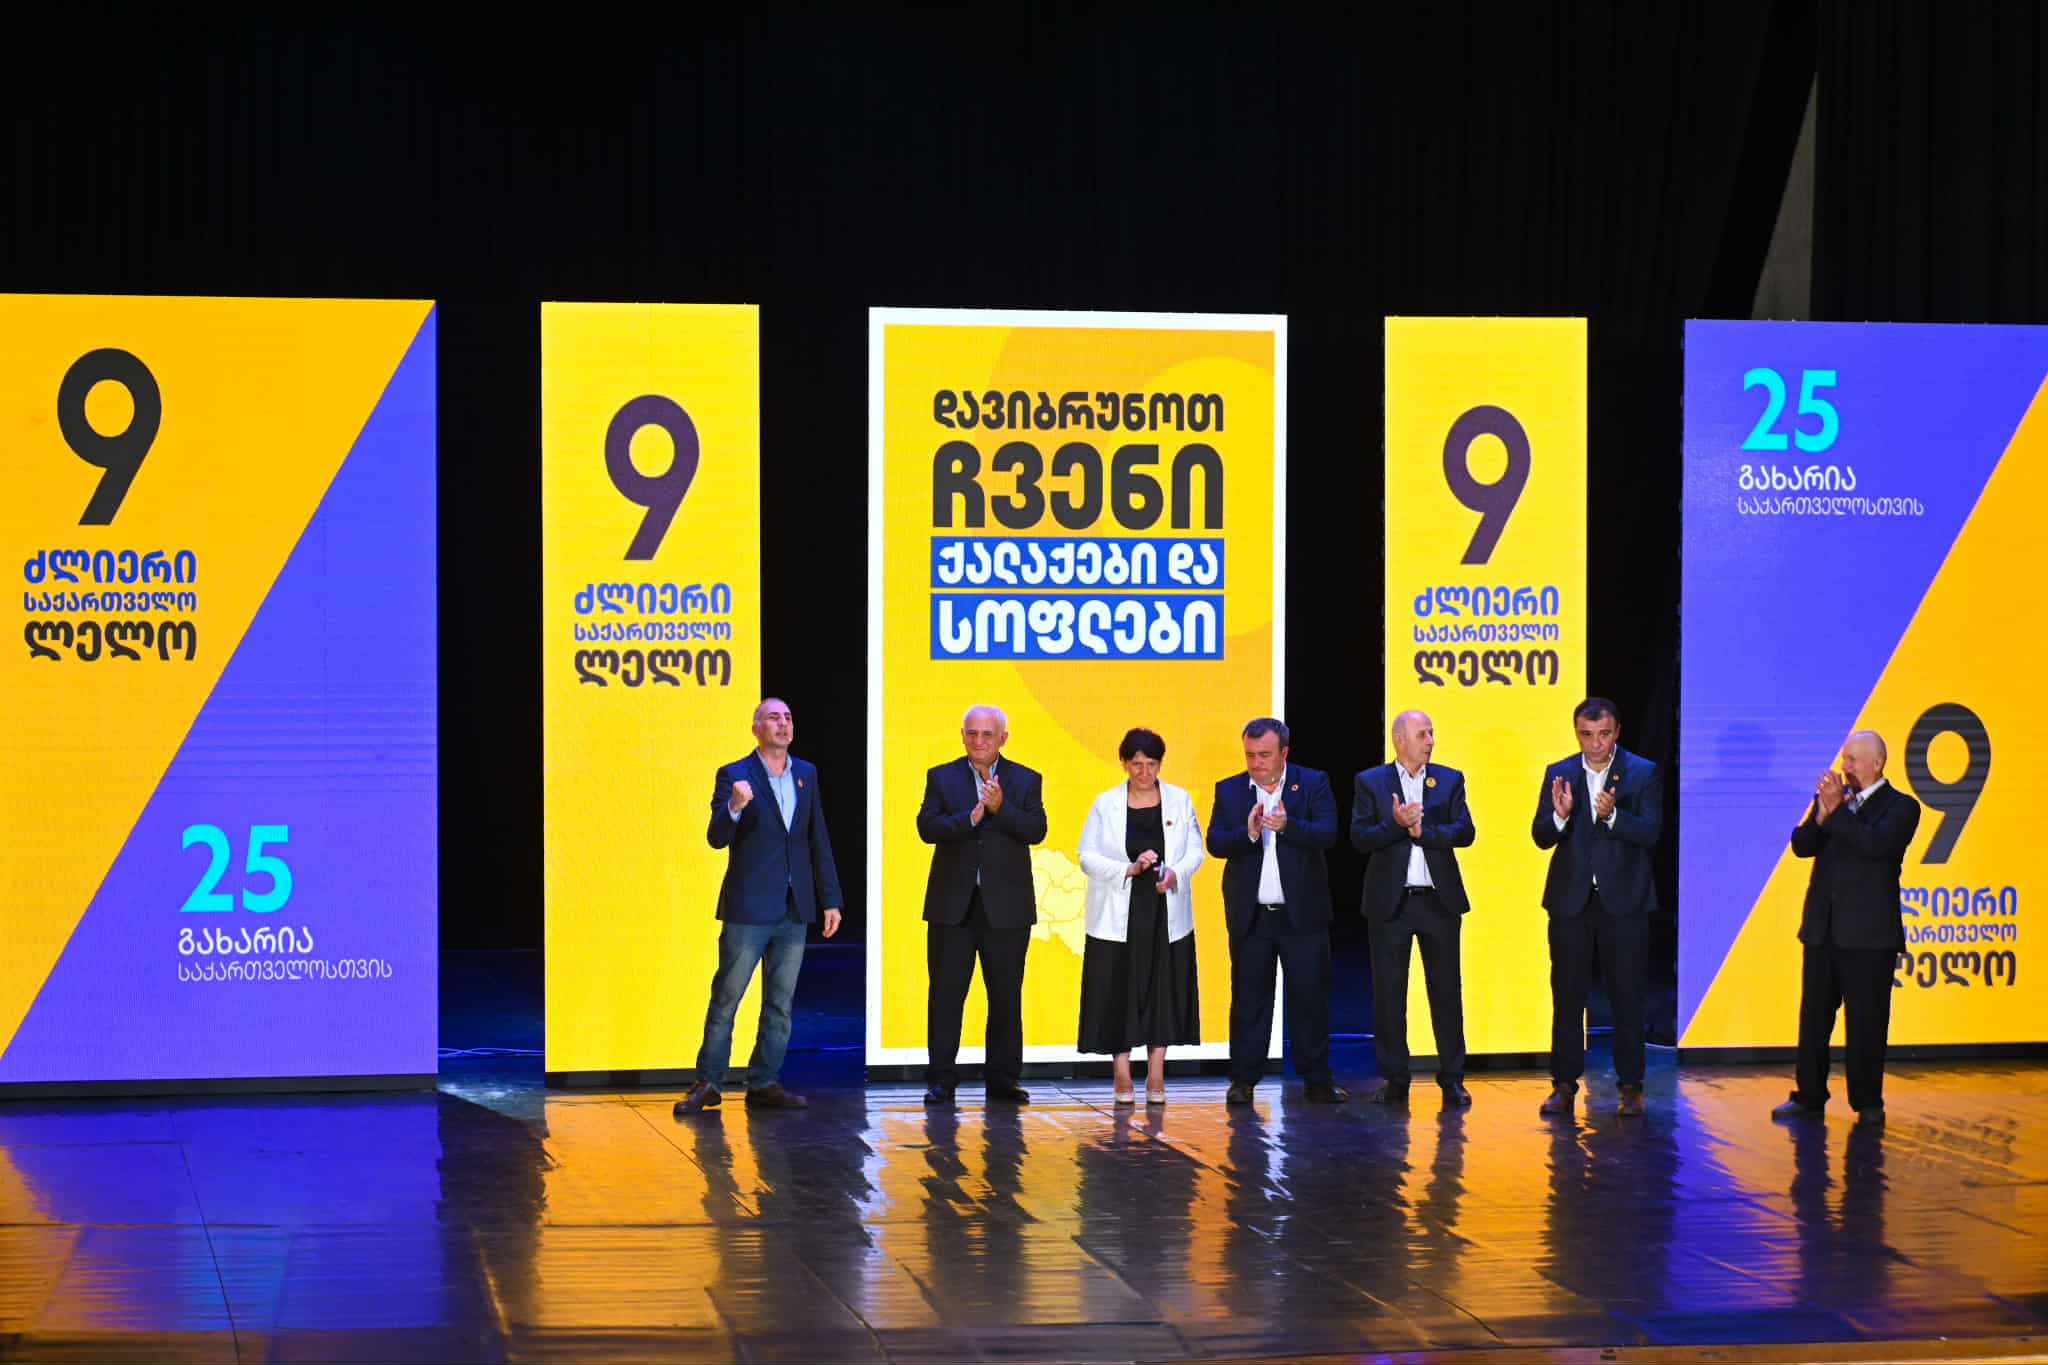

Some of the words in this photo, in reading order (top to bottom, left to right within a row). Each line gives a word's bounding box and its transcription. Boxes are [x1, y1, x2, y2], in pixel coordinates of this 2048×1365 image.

[933, 390, 1224, 432] დავიბრუნოთ
[1741, 367, 1841, 453] 25
[57, 348, 162, 525] 9
[605, 394, 701, 561] 9
[933, 441, 1224, 530] ჩვენი
[1443, 405, 1532, 565] 9
[1738, 464, 1857, 491] გახარია
[1737, 496, 1924, 516] საქართველოსთვის
[24, 550, 196, 584] ძლიერი
[938, 541, 1157, 585] ქალაქები
[1168, 542, 1218, 585] და
[24, 592, 197, 612] საქართველო
[574, 583, 732, 615] ძლიერი
[1414, 586, 1560, 618] ძლიერი
[24, 621, 196, 661] ლელო
[574, 622, 732, 642] საქართველო
[939, 599, 1216, 654] სოფლები
[1413, 623, 1560, 643] საქართველო
[574, 649, 732, 688] ლელო
[1414, 649, 1560, 687] ლელო
[1904, 702, 1992, 864] 9
[180, 824, 293, 913] 25
[1900, 886, 2017, 916] ლიერი
[178, 927, 314, 955] გახარია
[1903, 924, 2017, 943] ართველო
[178, 959, 393, 982] საქართველოსთვის
